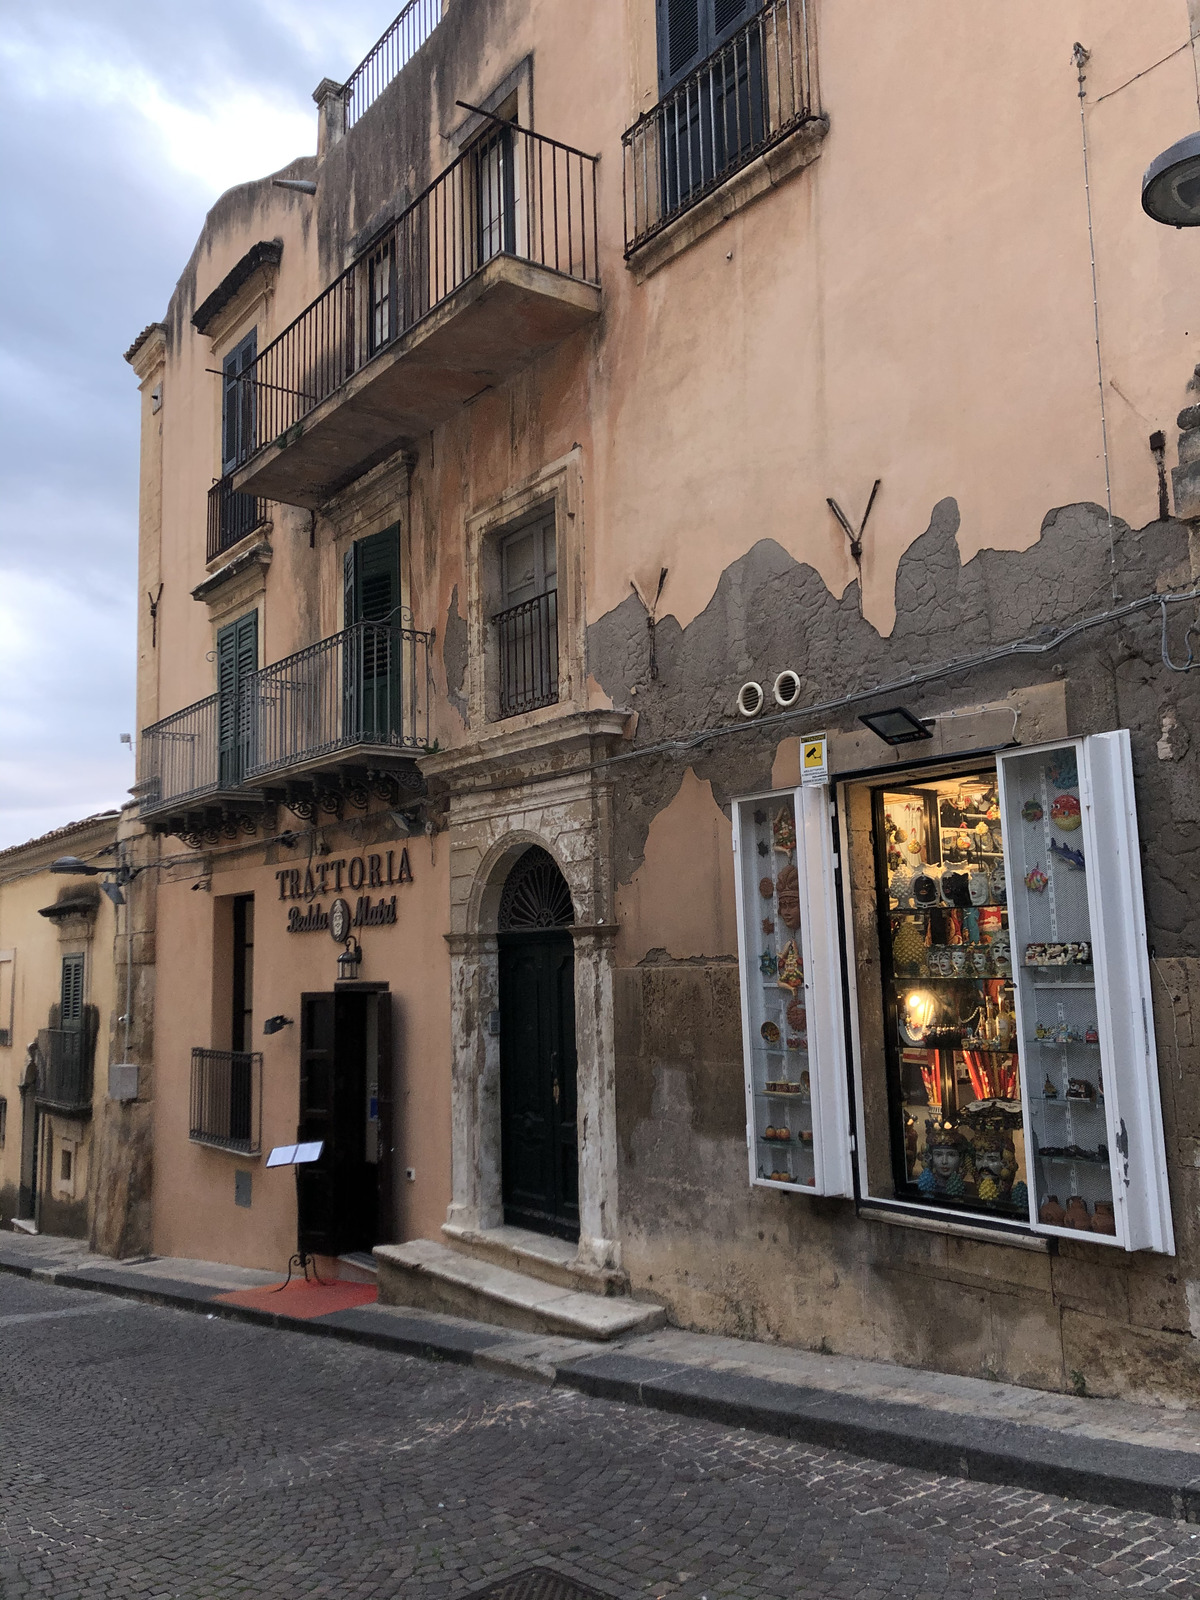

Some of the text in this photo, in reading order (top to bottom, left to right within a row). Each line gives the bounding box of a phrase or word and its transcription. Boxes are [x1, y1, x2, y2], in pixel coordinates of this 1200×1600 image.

[275, 847, 413, 900] TRATTORIA
[287, 895, 397, 932] Bedda Matri
